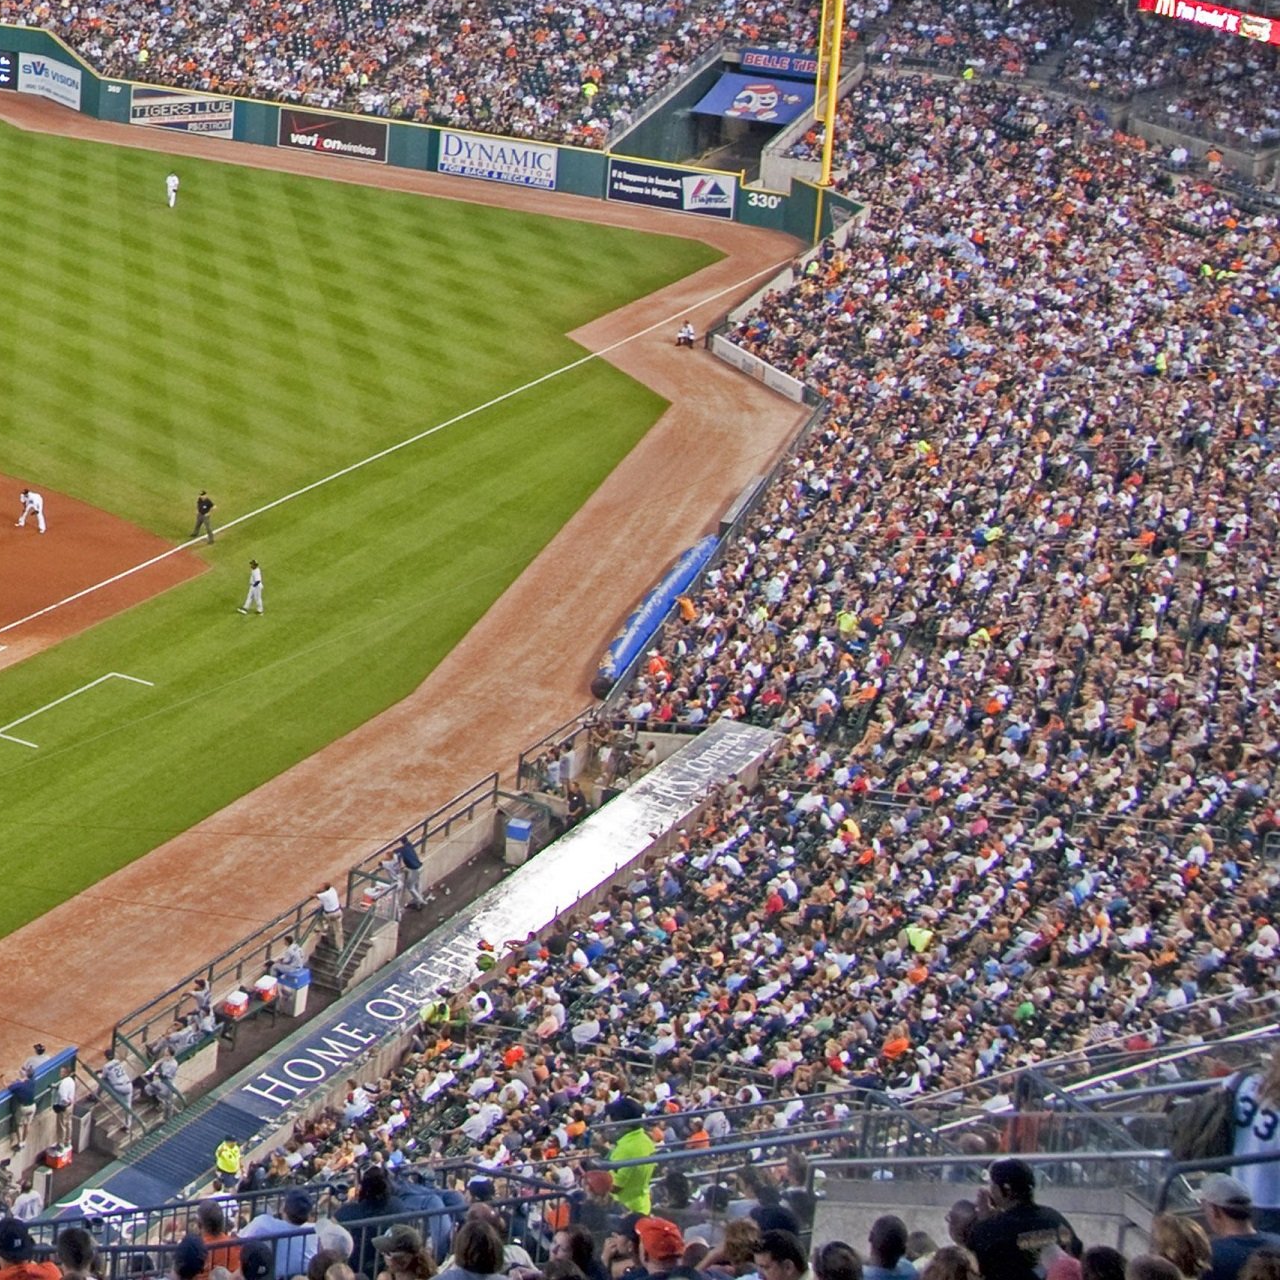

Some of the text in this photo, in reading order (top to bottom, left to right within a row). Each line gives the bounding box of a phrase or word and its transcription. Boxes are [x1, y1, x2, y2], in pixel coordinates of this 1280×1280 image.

[742, 51, 827, 75] BELLE TIRE
[50, 70, 79, 90] VISION
[134, 104, 192, 117] TIGERS
[443, 134, 552, 172] DYNAMIC
[242, 982, 421, 1107] HOME OF
[1234, 1095, 1279, 1142] 33
